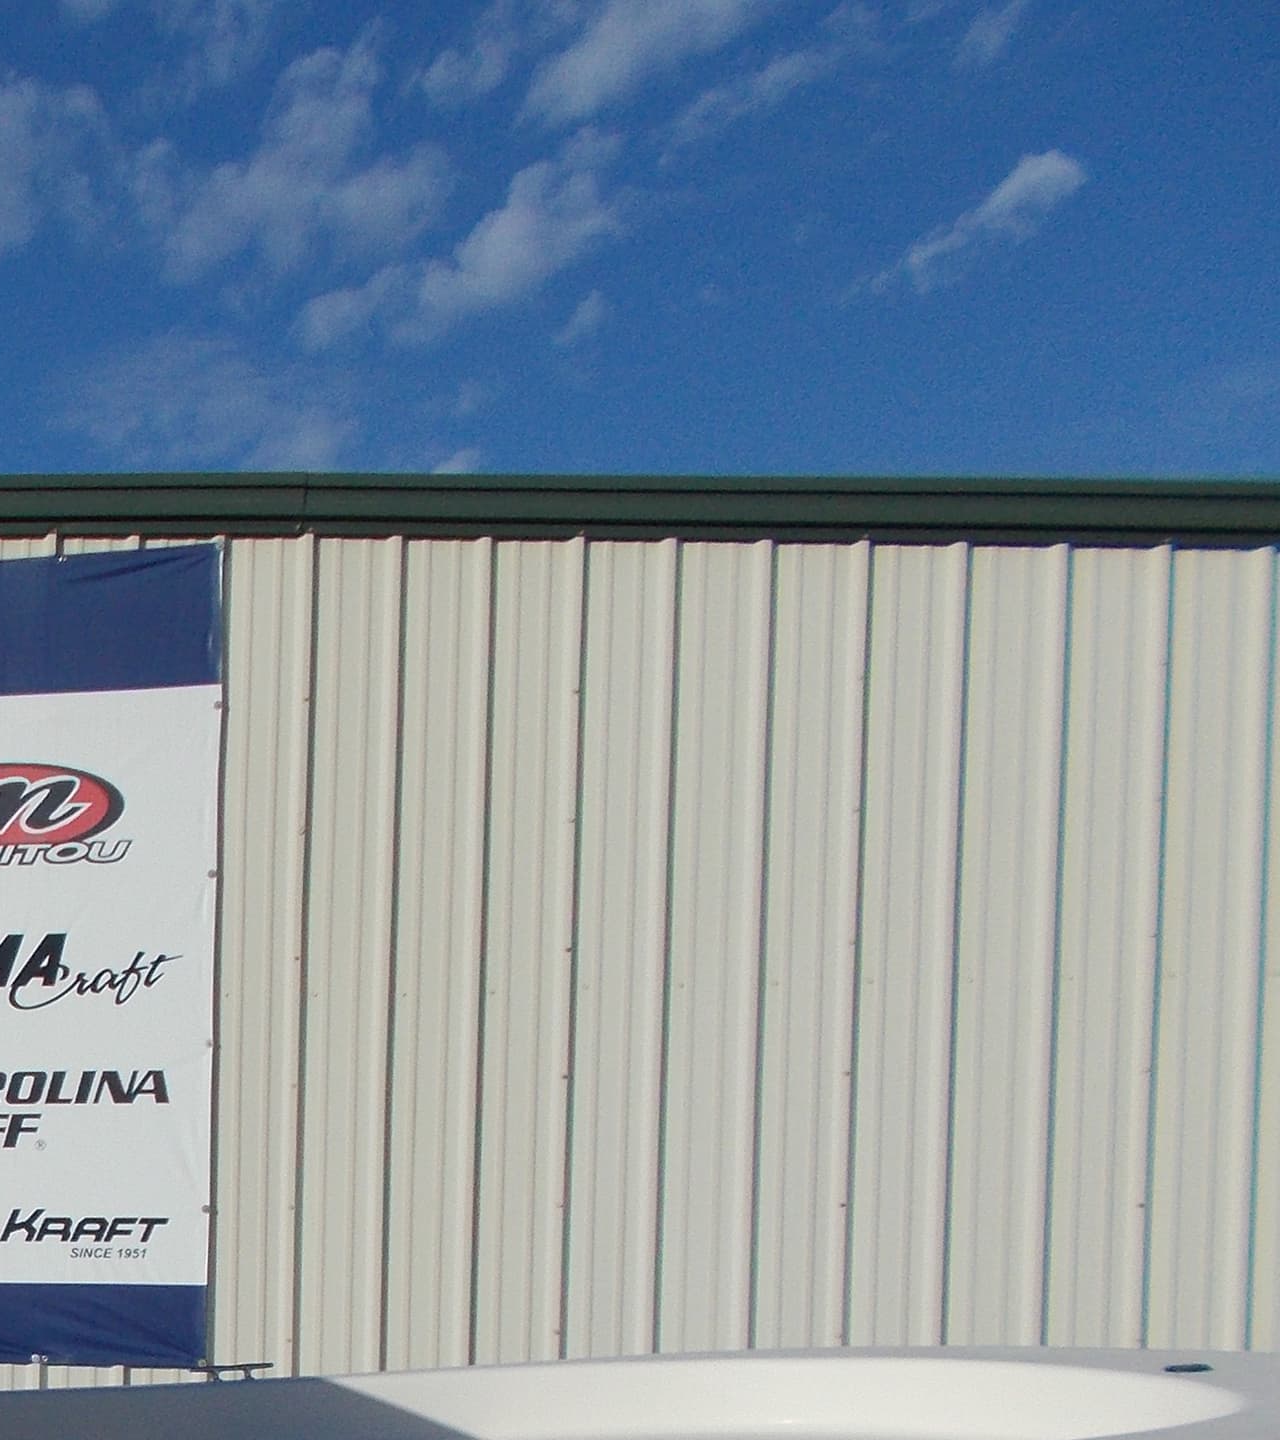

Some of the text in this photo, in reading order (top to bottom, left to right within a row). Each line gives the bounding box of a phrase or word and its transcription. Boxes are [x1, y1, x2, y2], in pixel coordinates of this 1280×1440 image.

[0, 1208, 170, 1243] KRAFT
[70, 1247, 147, 1259] SINCE 1951
